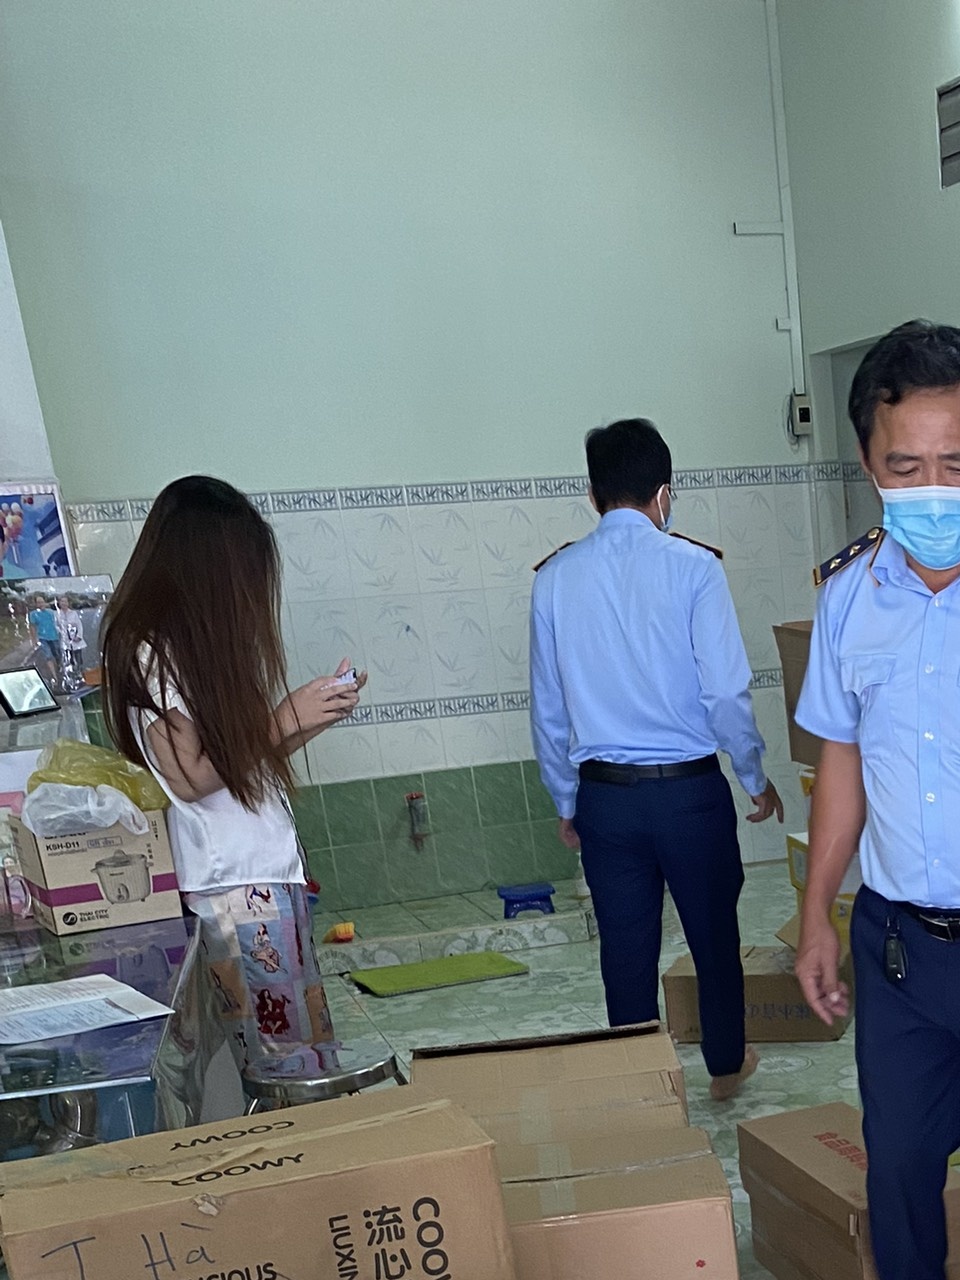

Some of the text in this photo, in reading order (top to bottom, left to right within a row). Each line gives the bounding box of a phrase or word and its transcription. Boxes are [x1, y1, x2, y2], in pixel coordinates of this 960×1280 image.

[45, 841, 80, 852] KSH-D11
[79, 910, 93, 918] THAI
[80, 913, 110, 923] ELECTRIC
[169, 1120, 295, 1151] COOWY
